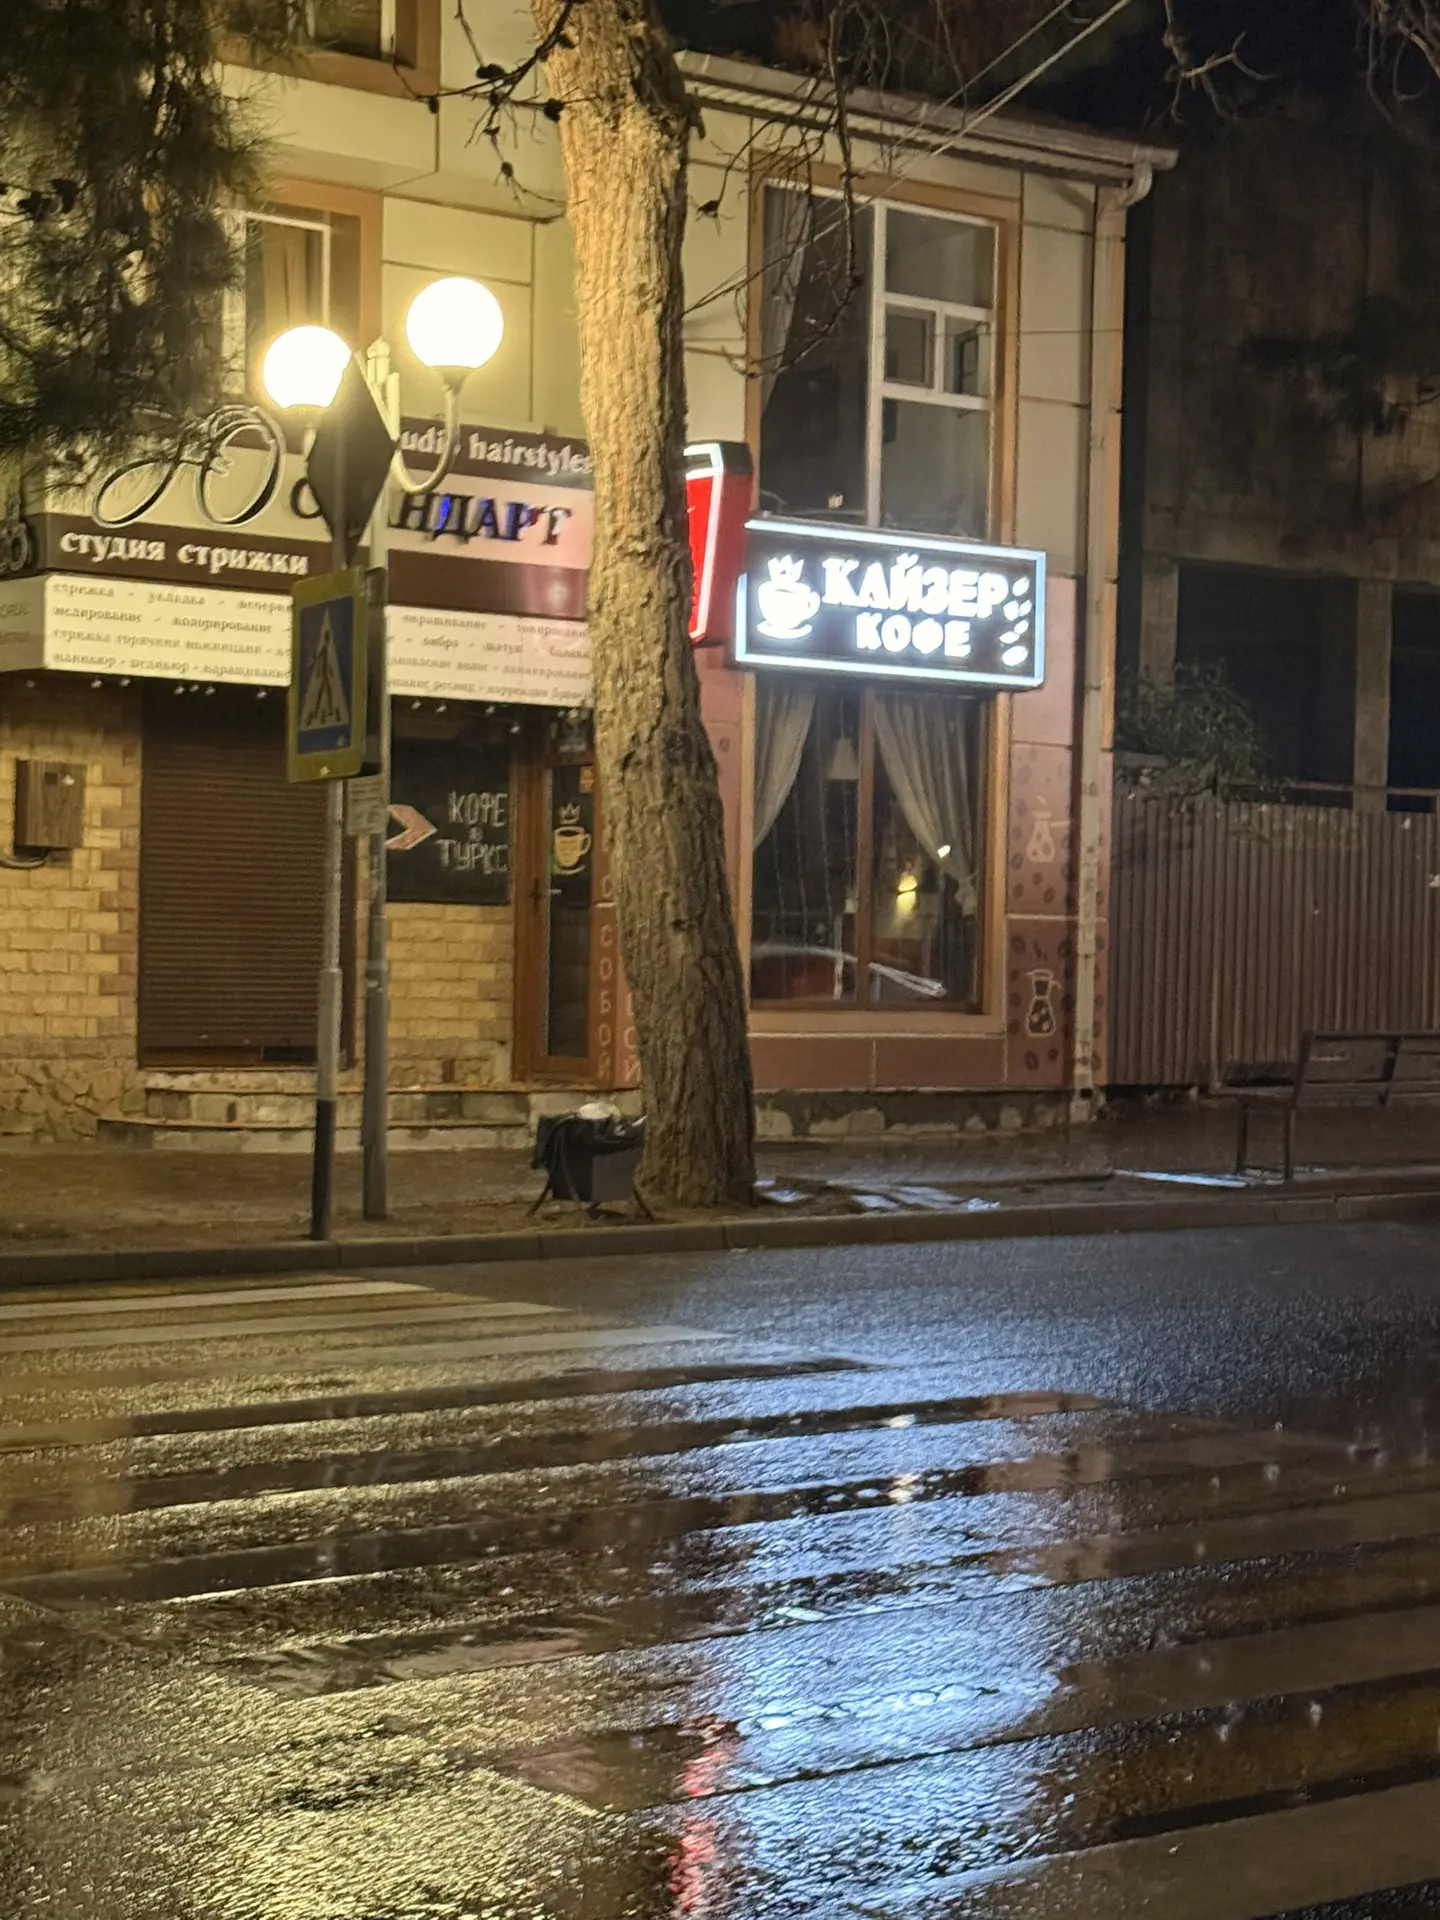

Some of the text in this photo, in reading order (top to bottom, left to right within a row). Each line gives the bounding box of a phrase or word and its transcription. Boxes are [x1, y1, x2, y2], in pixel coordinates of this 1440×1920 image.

[60, 532, 309, 576] студия стрижки
[821, 552, 1008, 619] КАЙЗЕР
[855, 612, 971, 657] КОФЕ
